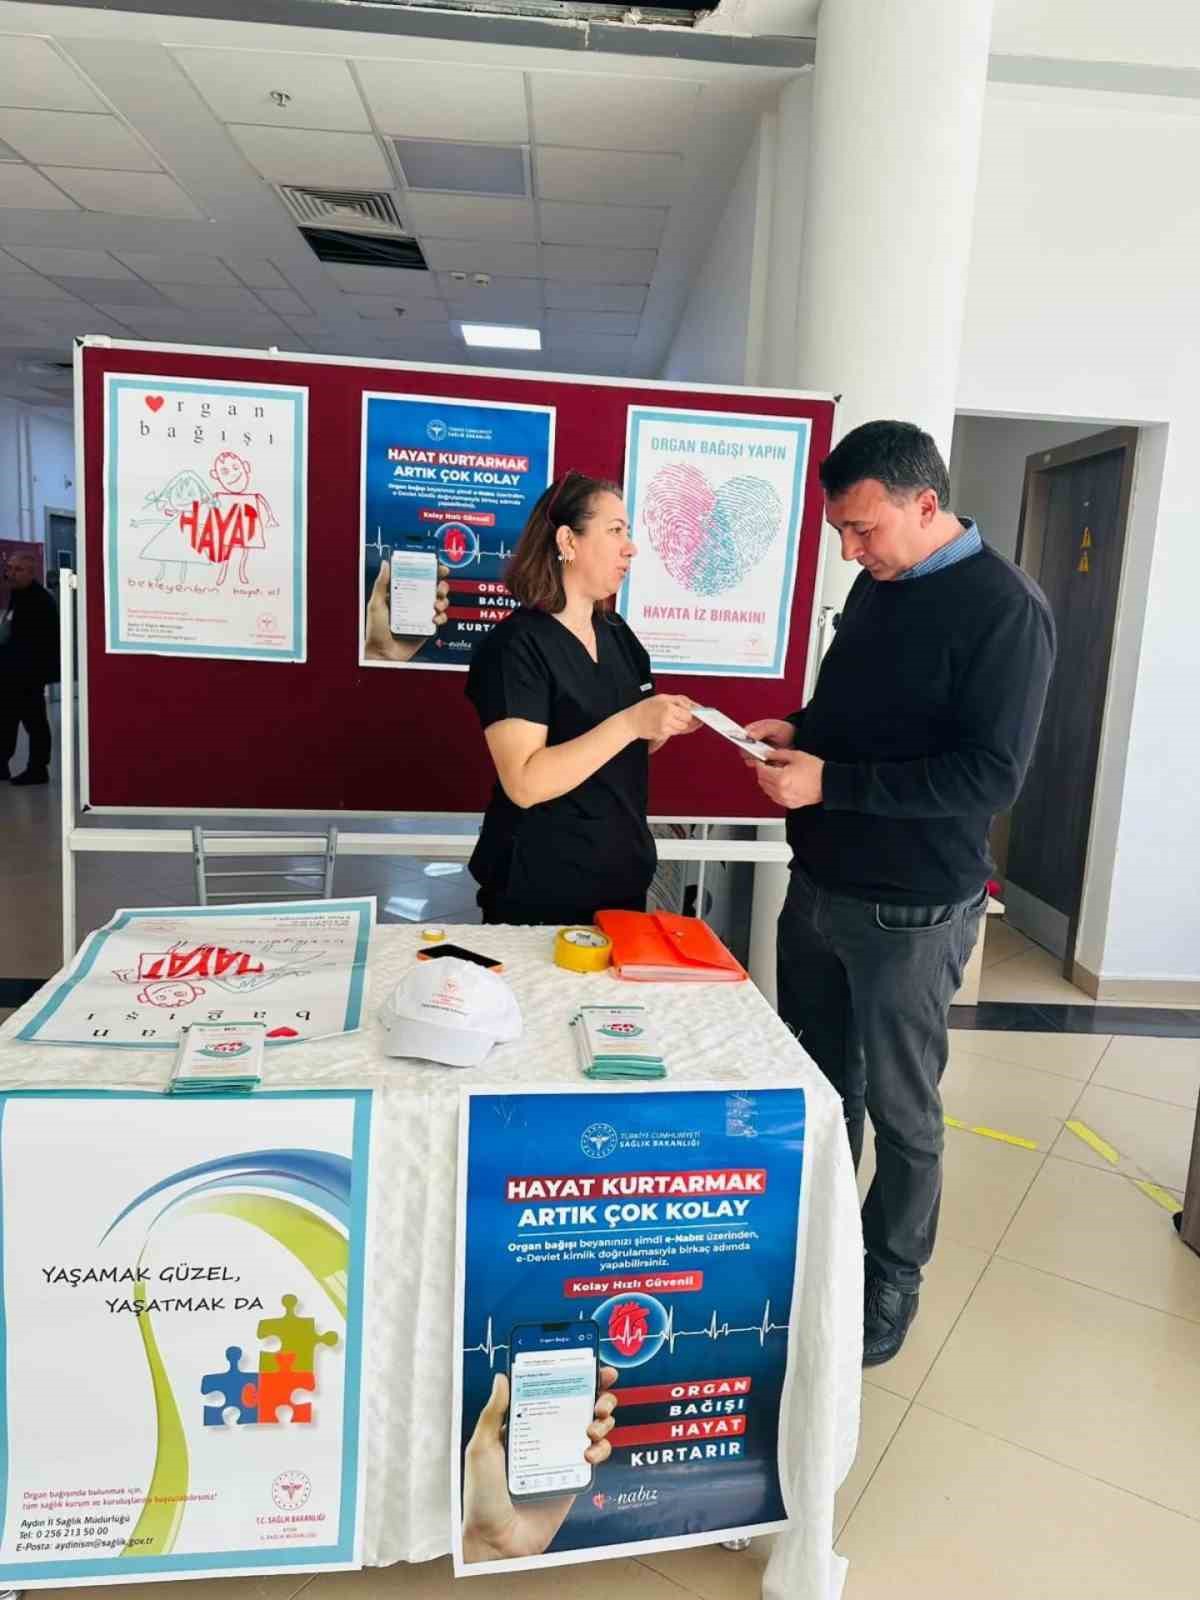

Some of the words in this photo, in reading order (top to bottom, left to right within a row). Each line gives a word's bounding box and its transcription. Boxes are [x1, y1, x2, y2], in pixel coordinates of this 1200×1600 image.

[651, 436, 696, 453] ORGAN
[699, 439, 744, 457] BAĞIŞI
[748, 443, 787, 460] YAPIN
[388, 449, 436, 463] HAYAT
[438, 451, 528, 471] KURTARMAK
[394, 465, 437, 480] ARTIK
[439, 468, 471, 484] ÇOK
[473, 470, 521, 486] KOLAY
[180, 500, 258, 563] HAYAT
[478, 583, 511, 595] ORG
[480, 610, 512, 620] HAY
[643, 606, 691, 621] HAYATA
[693, 606, 706, 622] İZ
[709, 608, 766, 625] BIRAKIN!
[457, 622, 496, 632] KURT
[508, 1178, 595, 1200] HAYAT
[602, 1173, 764, 1197] KURTARMAK
[517, 1206, 598, 1228] ARTIK
[604, 1203, 658, 1228] ÇOK
[666, 1200, 751, 1220] KOLAY
[508, 1242, 542, 1254] Organ
[545, 1239, 577, 1252] bağışı
[634, 1235, 663, 1247] şimdi
[679, 1244, 711, 1256] birkaç
[42, 1265, 152, 1288] YAŞAMAK
[159, 1262, 242, 1283] GÜZEL,
[572, 1281, 609, 1294] Kolay
[105, 1296, 226, 1316] YAŞATMAK
[233, 1297, 264, 1311] DA
[671, 1381, 749, 1398] ORGAN
[669, 1398, 746, 1416] BAĞIŞI
[671, 1419, 743, 1437] HAYAT
[631, 1442, 741, 1467] KURTARIR
[21, 1518, 46, 1529] Aydın
[36, 1530, 42, 1538] 0
[84, 1528, 95, 1536] 50
[97, 1527, 109, 1535] 00
